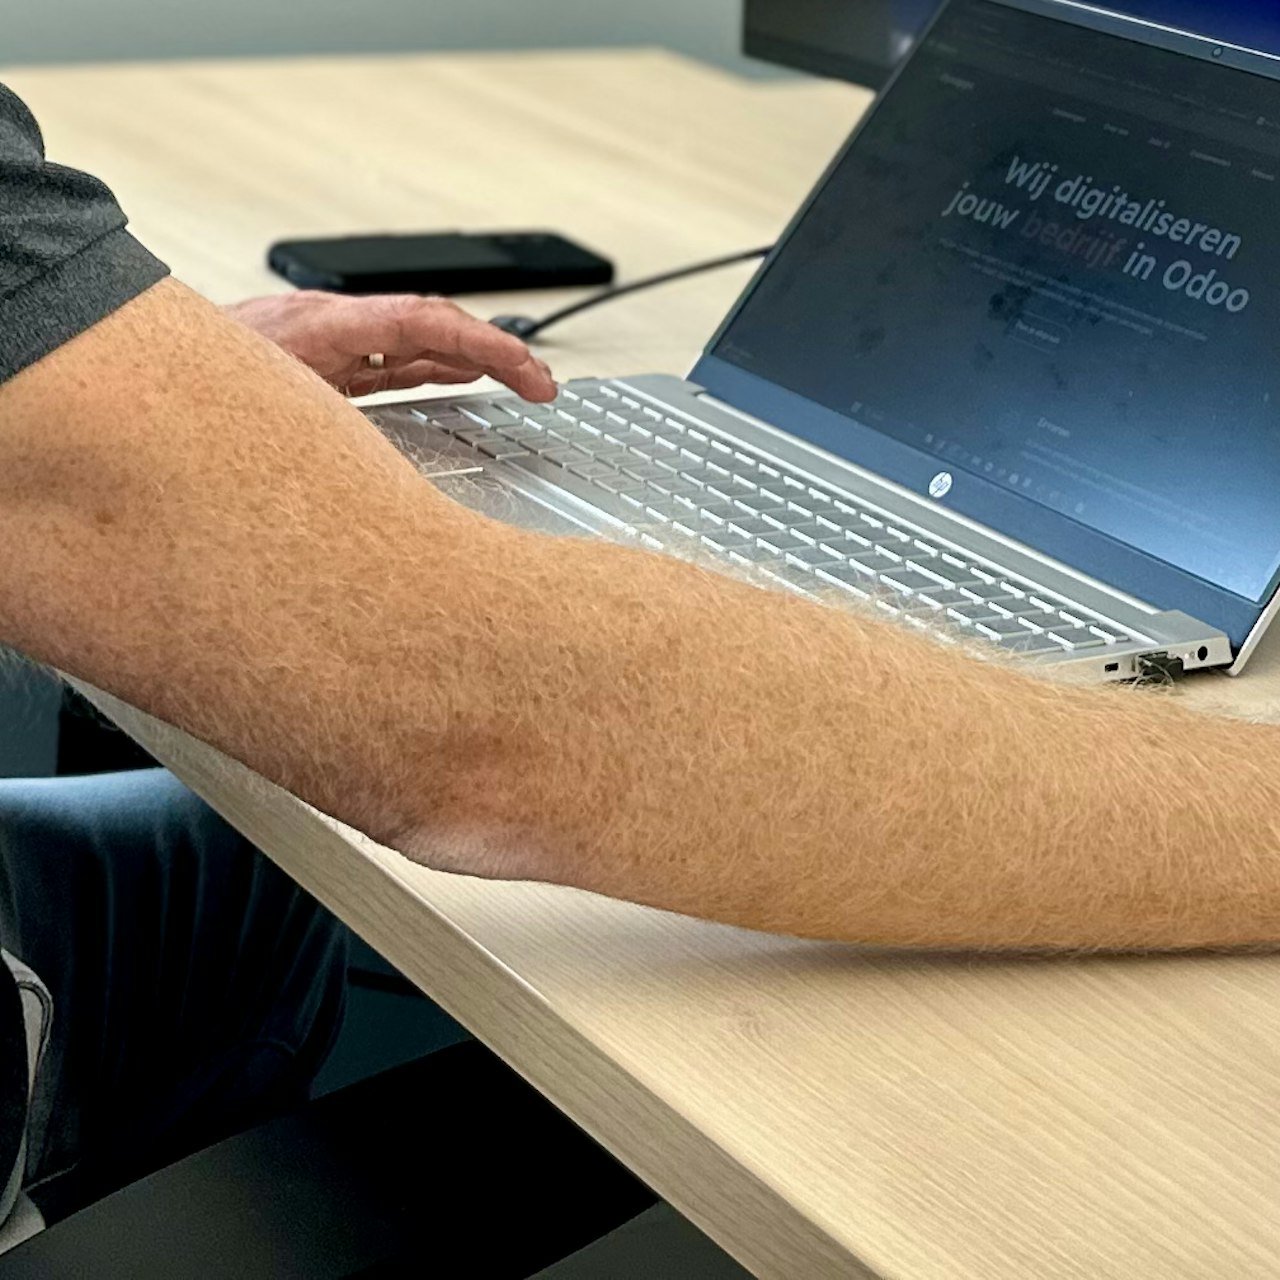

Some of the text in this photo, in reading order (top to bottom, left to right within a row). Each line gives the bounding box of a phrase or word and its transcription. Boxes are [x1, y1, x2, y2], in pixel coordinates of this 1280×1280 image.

[940, 181, 1020, 229] jouw
[1021, 209, 1127, 269] bedrijf
[1122, 241, 1157, 281] in
[1162, 259, 1249, 312] Odoo
[1005, 155, 1242, 260] Wij digitaliseren
